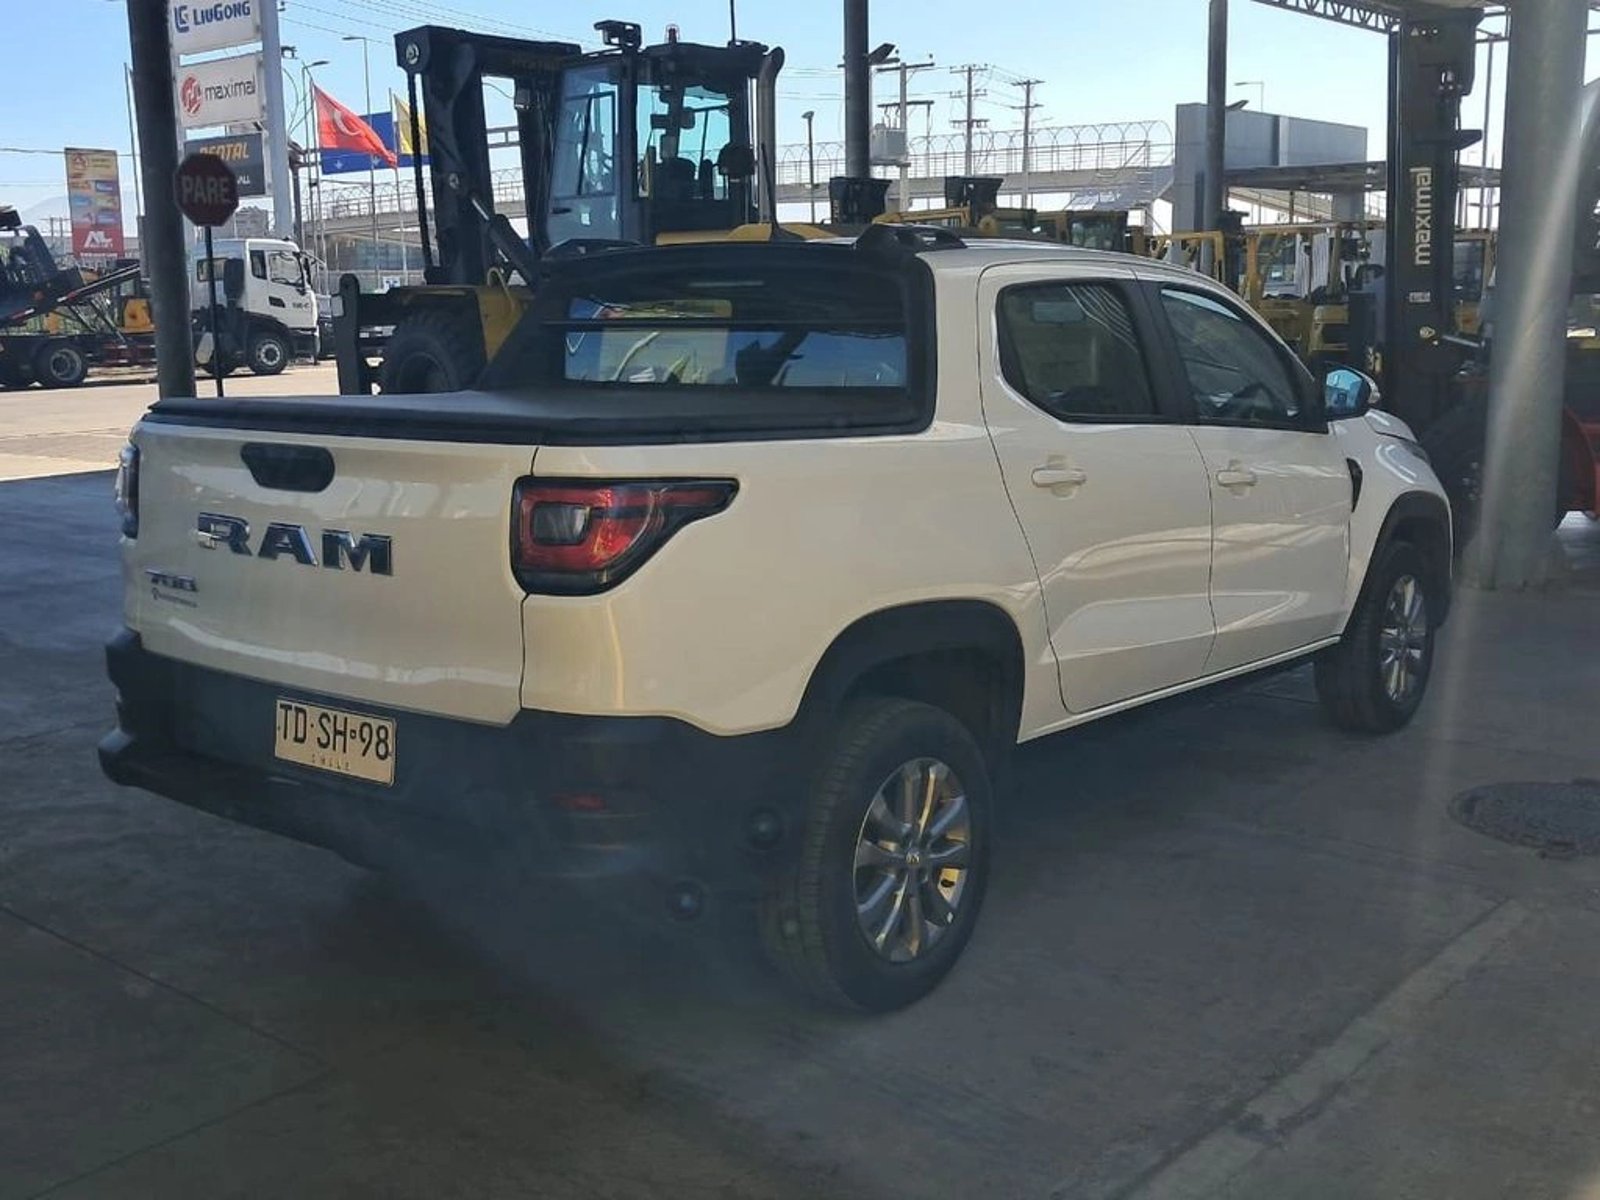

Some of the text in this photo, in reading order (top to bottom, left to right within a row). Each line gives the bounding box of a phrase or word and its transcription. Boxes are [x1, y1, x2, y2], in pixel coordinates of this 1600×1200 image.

[204, 74, 256, 100] maximal
[181, 174, 232, 205] PARE
[1409, 167, 1432, 265] maximal
[198, 511, 393, 576] RAM
